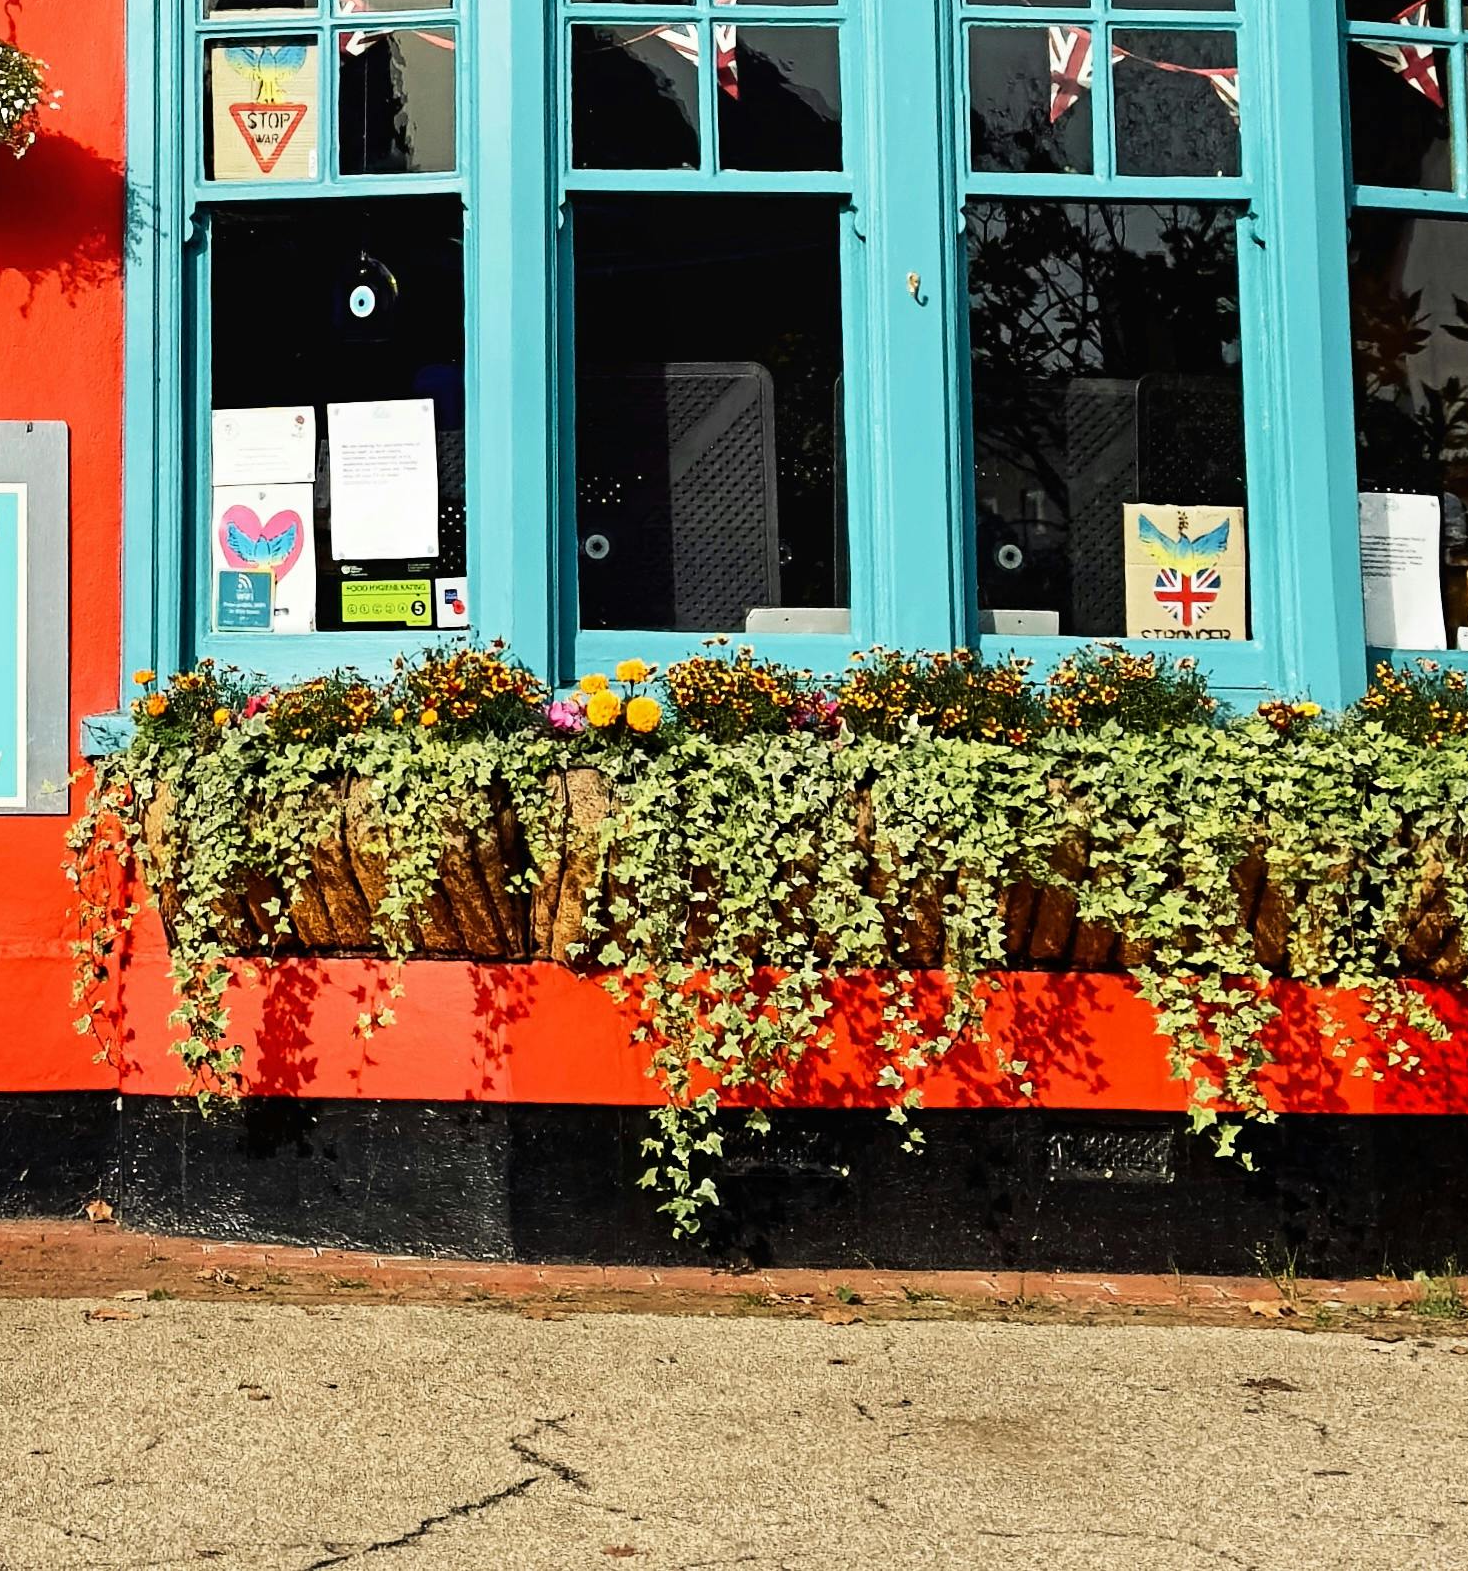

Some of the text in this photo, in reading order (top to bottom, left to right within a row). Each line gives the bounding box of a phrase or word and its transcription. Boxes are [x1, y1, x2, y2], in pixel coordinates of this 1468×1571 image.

[247, 112, 290, 129] STOP
[255, 134, 279, 144] WAR
[413, 602, 424, 614] 5
